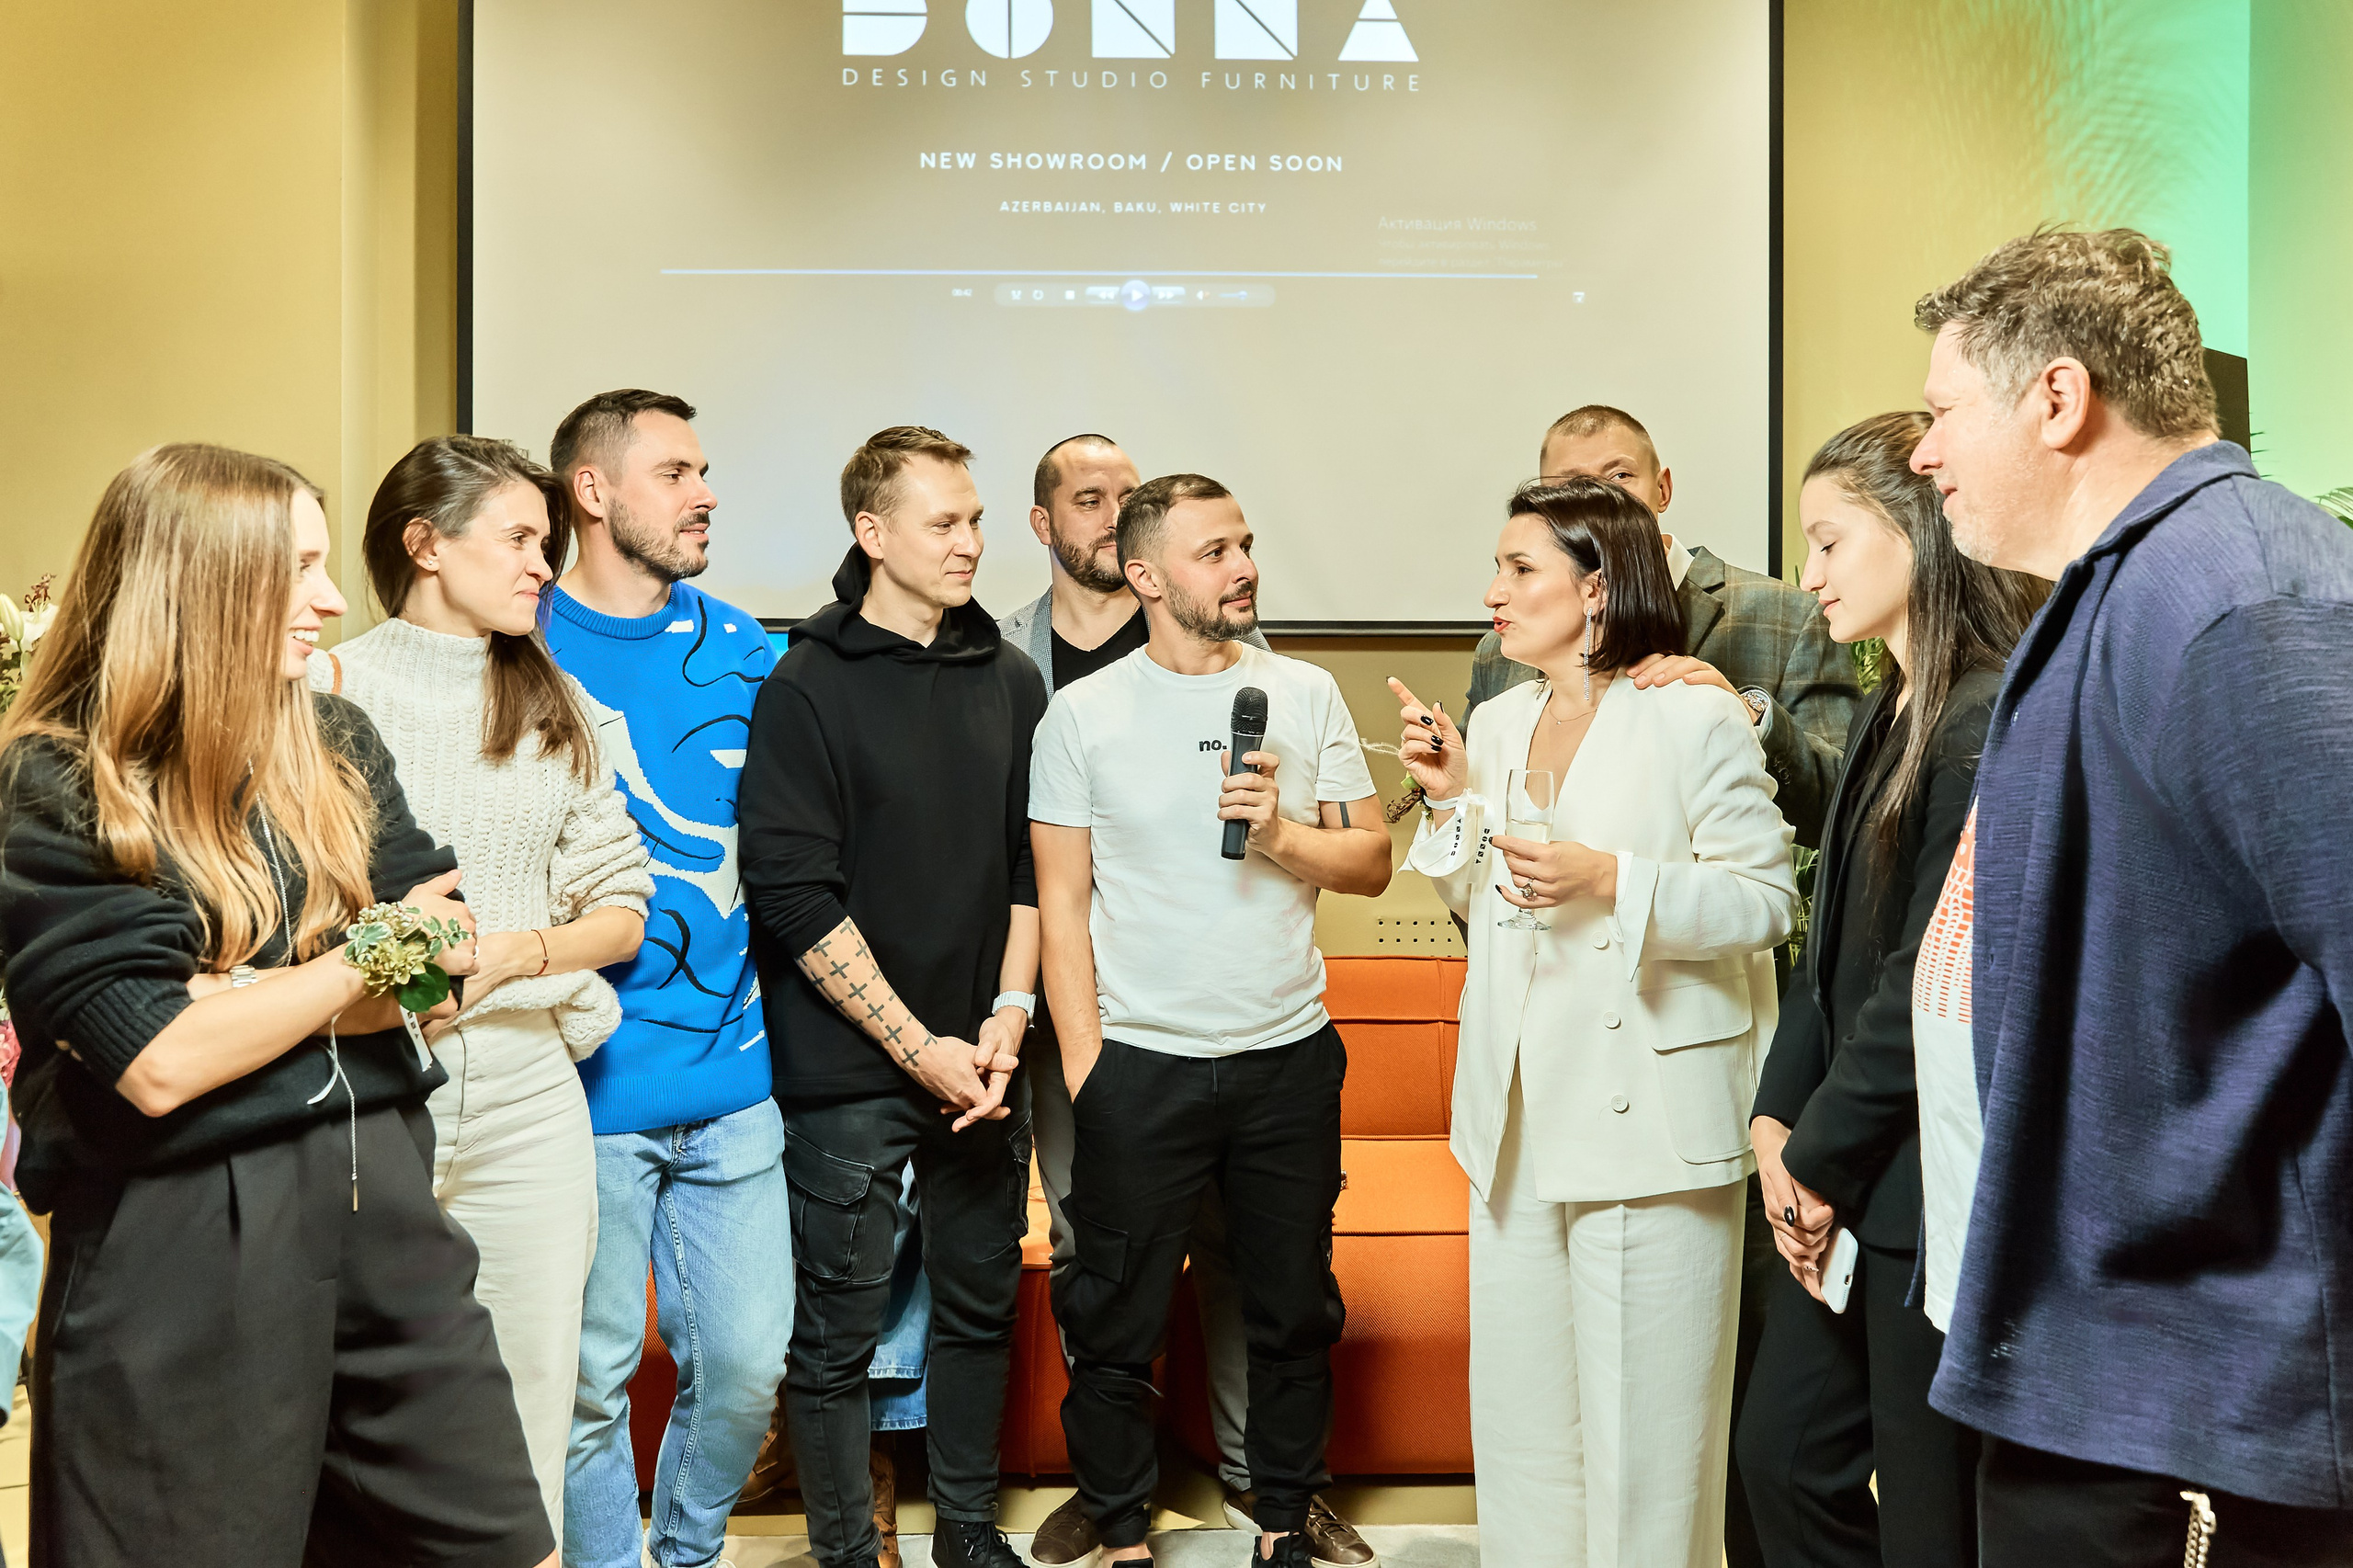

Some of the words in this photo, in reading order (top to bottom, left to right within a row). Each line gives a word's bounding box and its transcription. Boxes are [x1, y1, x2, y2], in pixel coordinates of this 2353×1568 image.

[843, 0, 1419, 62] DONNA
[842, 68, 986, 87] DESIGN
[1020, 70, 1168, 89] STUDIO
[1201, 72, 1420, 92] FURNITURE
[920, 153, 976, 169] NEW
[990, 153, 1146, 169] SHOWROOM
[1186, 154, 1256, 171] OPEN
[1269, 155, 1343, 172] SOON
[1000, 200, 1107, 214] AZERBAIJAN,
[1114, 201, 1162, 214] BAKU,
[1170, 201, 1221, 213] WHITE
[1229, 202, 1267, 213] CITY
[1378, 216, 1461, 232] Активация
[1466, 217, 1538, 231] Windows
[1199, 739, 1228, 752] no.
